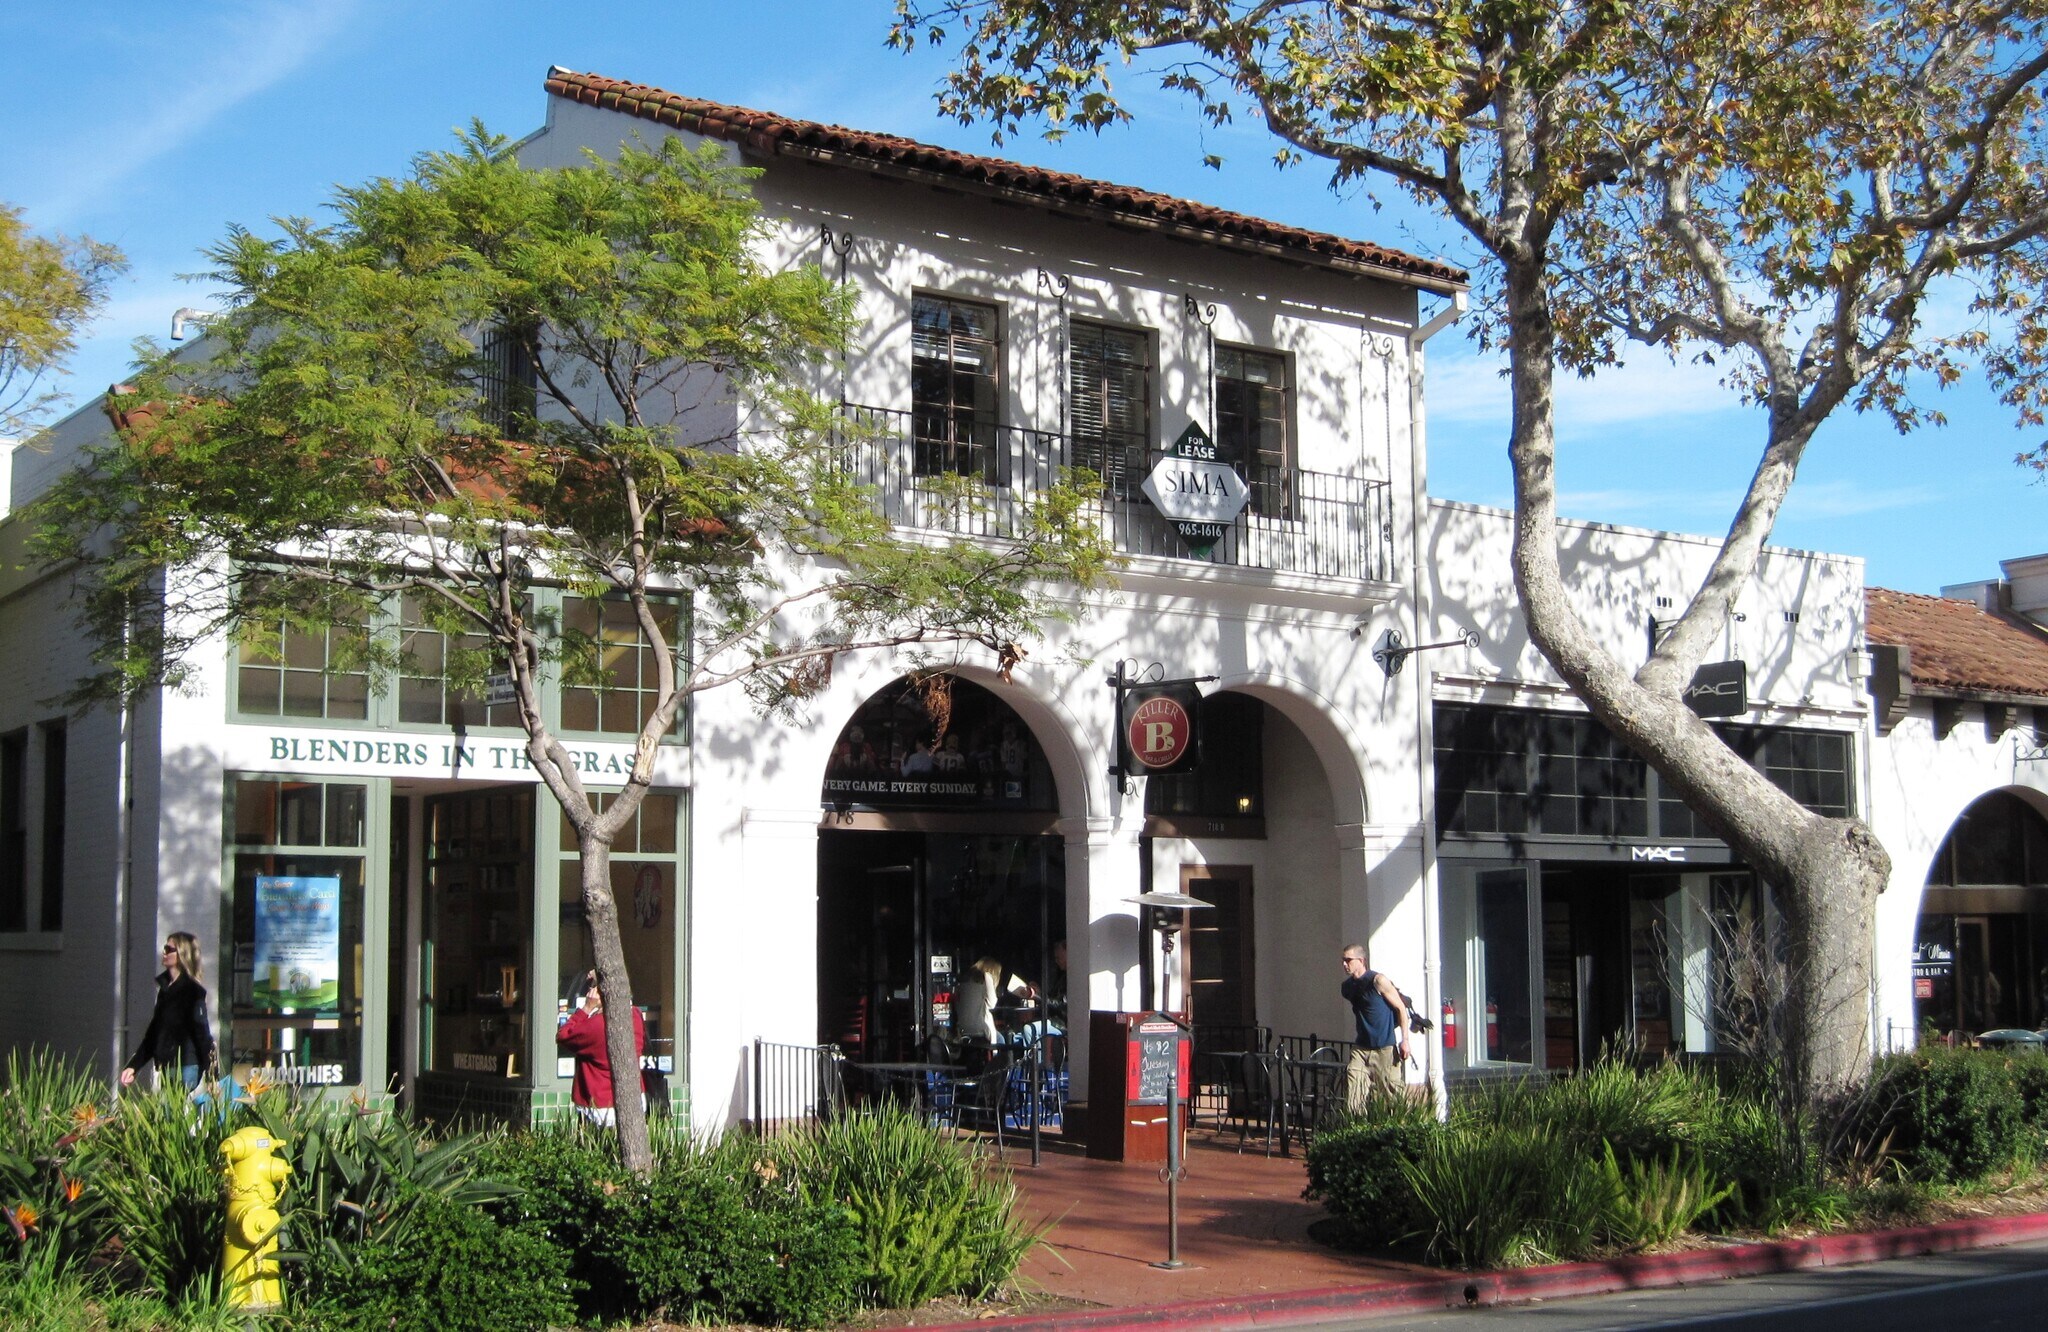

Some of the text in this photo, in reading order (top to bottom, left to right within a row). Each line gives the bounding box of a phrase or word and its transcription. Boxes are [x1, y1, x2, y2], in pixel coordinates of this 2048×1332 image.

[1188, 436, 1204, 446] FOR
[1177, 444, 1216, 459] LEASE
[1164, 469, 1229, 497] SIMA
[1178, 523, 1222, 537] 965-1616
[1137, 700, 1179, 724] KILLER
[270, 737, 635, 775] BLENDERS IN TH GRAS
[822, 779, 977, 795] VERY GAME. EVERY SUNDAY.
[1632, 846, 1686, 861] MAC
[453, 1053, 497, 1073] WHEATGRASS
[250, 1063, 344, 1084] SMOOTHIES
